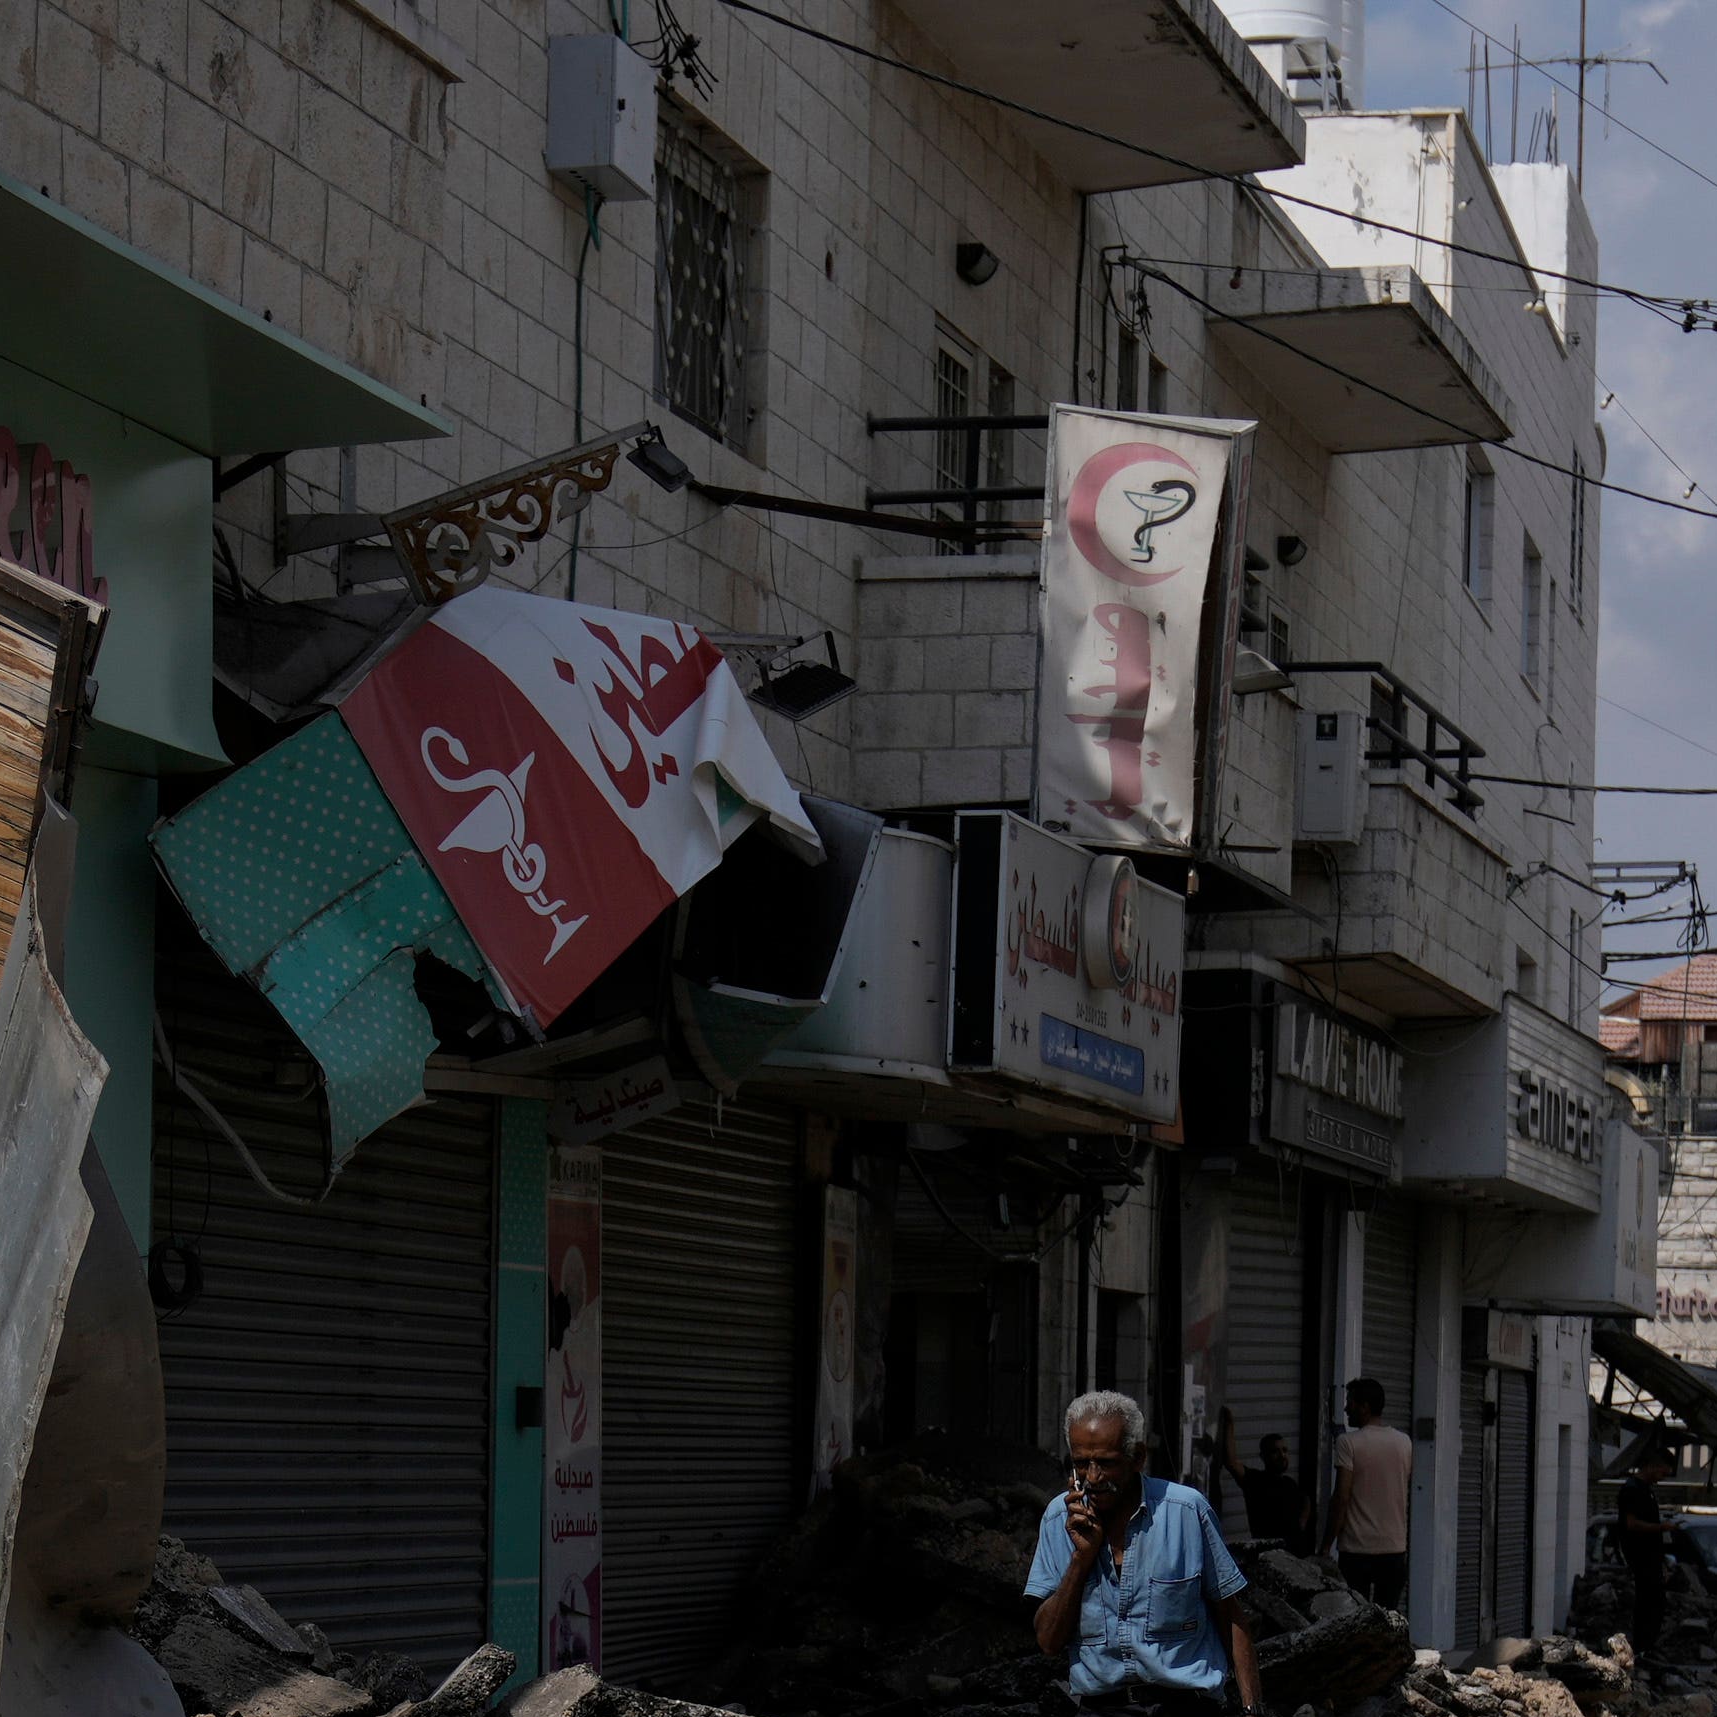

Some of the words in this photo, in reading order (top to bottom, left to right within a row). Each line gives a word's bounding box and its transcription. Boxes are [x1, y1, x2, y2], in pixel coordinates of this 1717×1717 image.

[1064, 602, 1167, 821] صيدلية
[1007, 868, 1079, 991] فلسطين
[565, 1077, 665, 1126] صيدلية
[1285, 1003, 1318, 1087] LA
[1320, 1017, 1350, 1098] VIE
[1355, 1033, 1405, 1121] HOME
[1307, 1111, 1342, 1147] GIFTS
[555, 1459, 593, 1495] صيدلية
